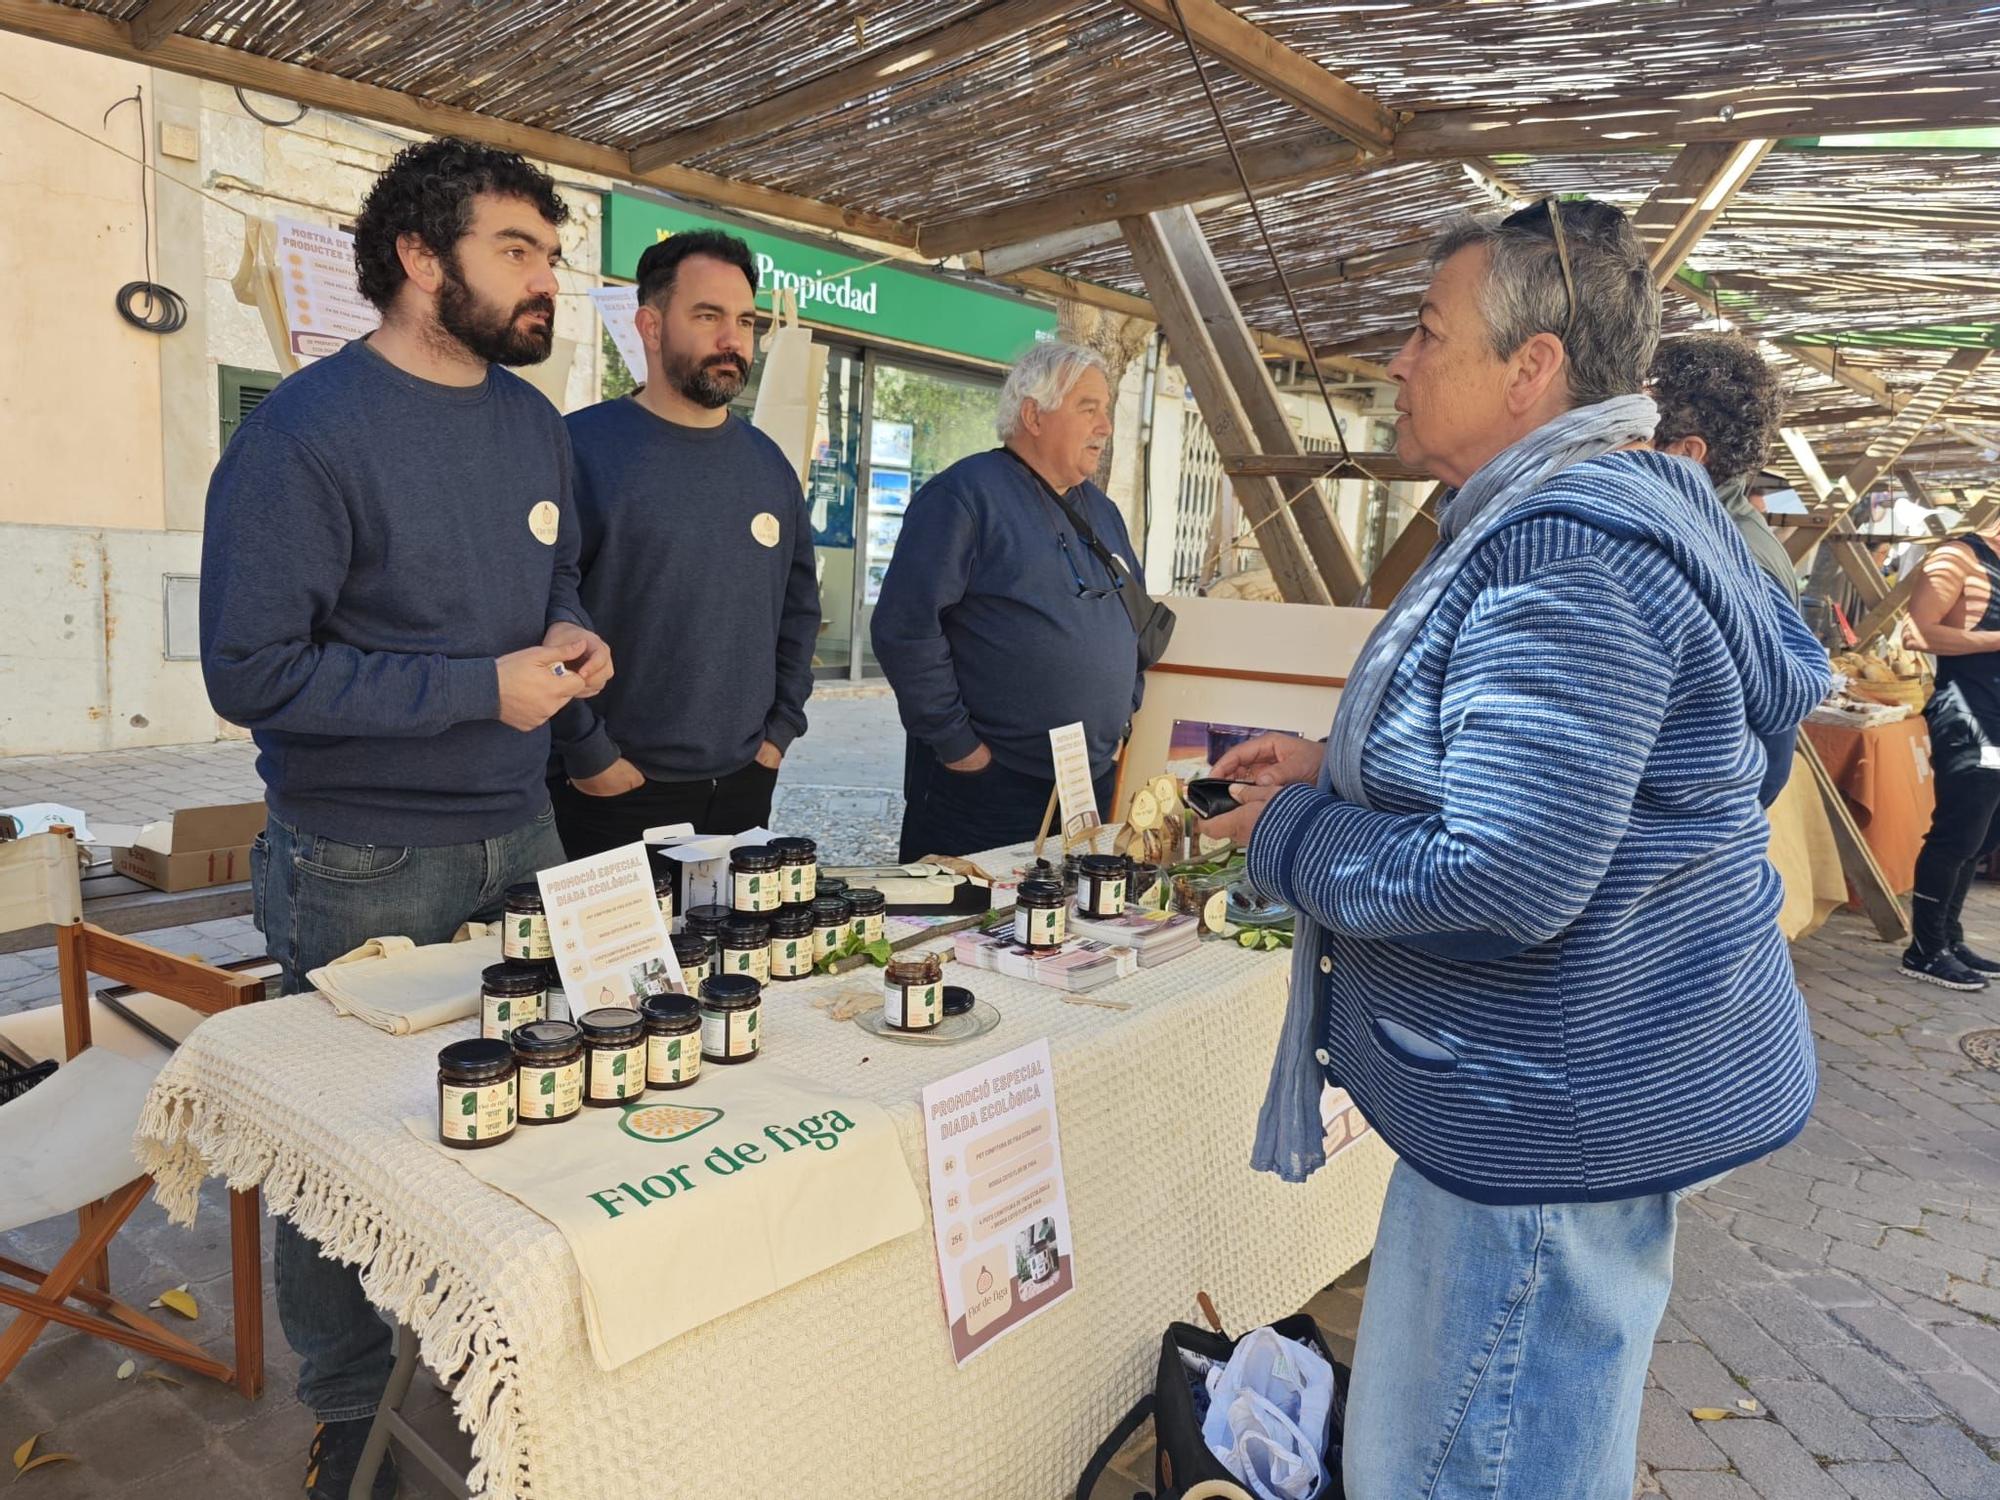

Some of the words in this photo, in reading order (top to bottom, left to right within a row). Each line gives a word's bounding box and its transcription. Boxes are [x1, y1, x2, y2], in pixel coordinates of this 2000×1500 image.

[283, 237, 343, 260] PRODUCTES
[291, 228, 333, 246] MOSTRA
[336, 239, 349, 250] DE
[757, 253, 877, 315] Propiedad
[546, 868, 597, 895] PROMOCIÓ
[598, 856, 643, 880] ESPECIAL
[556, 889, 587, 907] DIADA
[931, 1079, 991, 1121] PROMOCIÓ
[993, 1060, 1045, 1094] ESPECIAL
[941, 1112, 979, 1141] DIADA
[980, 1083, 1041, 1122] ECOLÒGICA
[586, 1164, 697, 1219] Flor
[704, 1142, 767, 1175] de
[763, 1109, 856, 1151] figa
[968, 1303, 981, 1319] Flor
[983, 1296, 992, 1307] de
[993, 1287, 1009, 1302] figa
